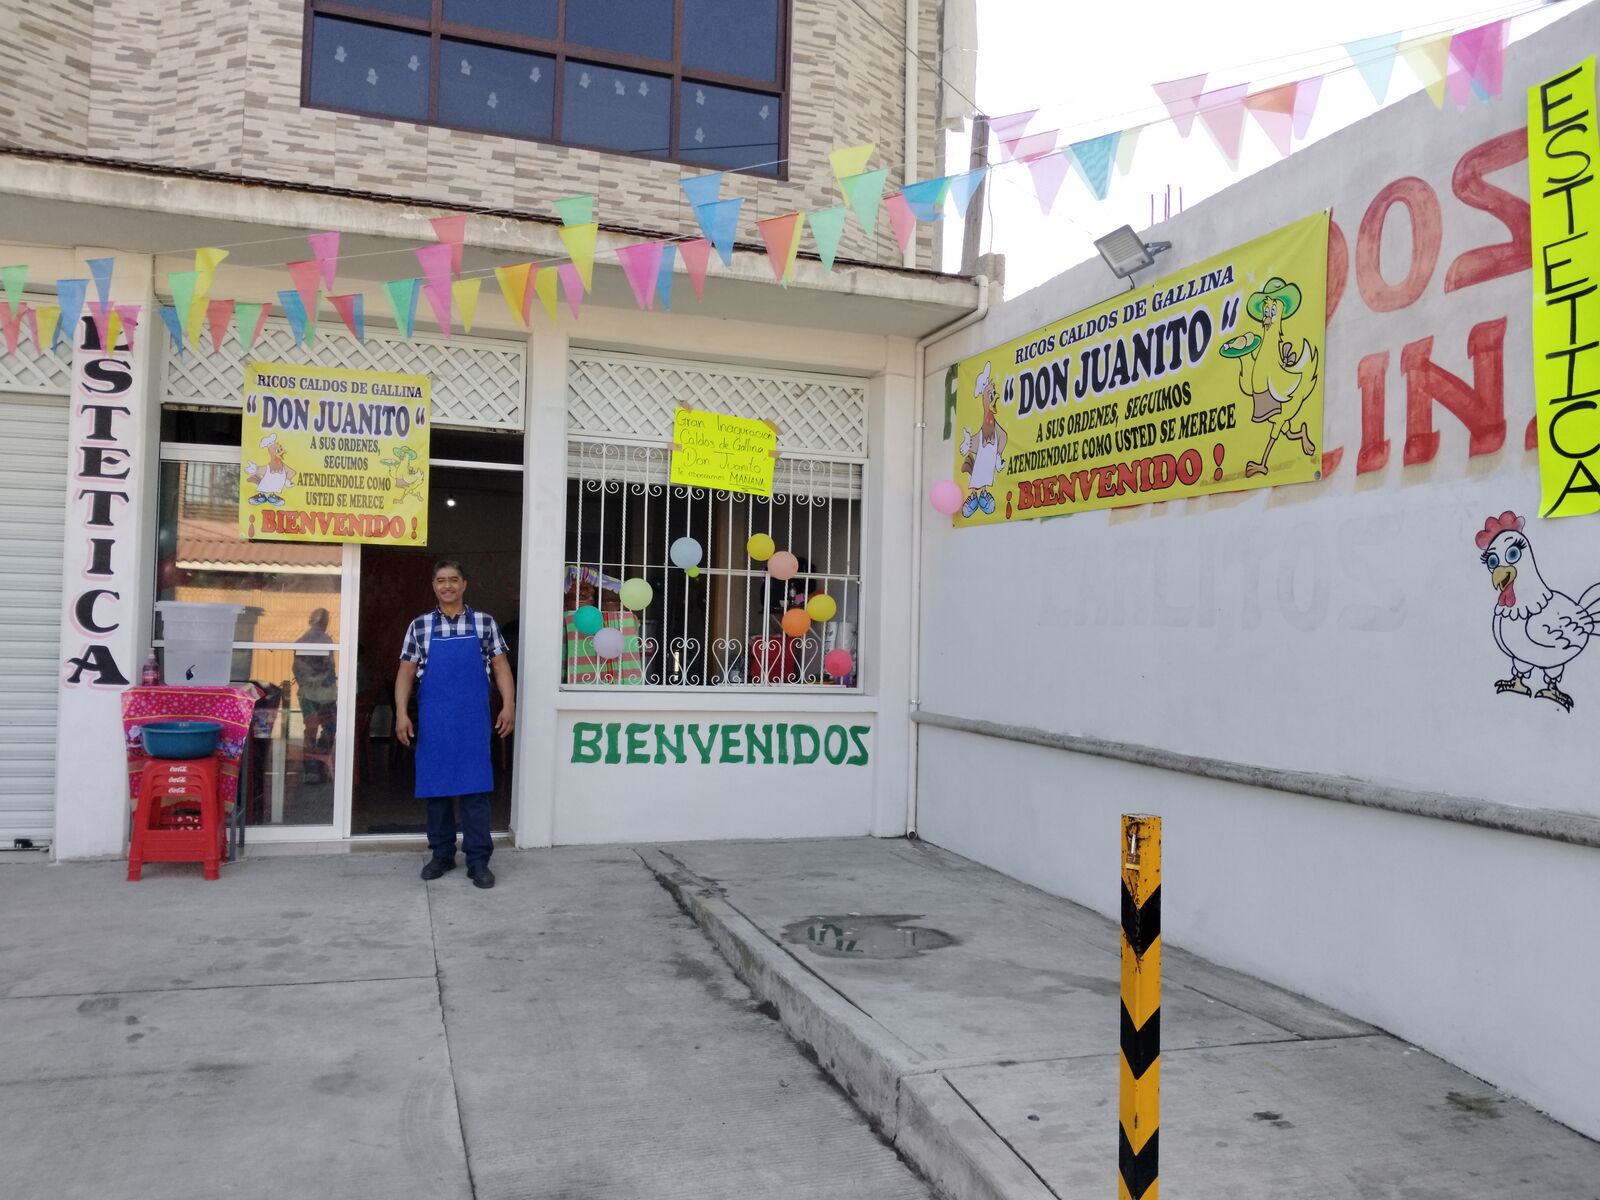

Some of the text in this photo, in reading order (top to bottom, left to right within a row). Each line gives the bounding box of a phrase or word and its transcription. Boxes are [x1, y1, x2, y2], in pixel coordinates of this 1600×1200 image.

[1540, 66, 1600, 519] ESTETICA
[1015, 265, 1234, 364] RICOS CALDOS DE GALLINA
[1018, 359, 1070, 415] DON
[1074, 309, 1212, 398] JUANITO
[257, 375, 422, 398] RICOS CALDOS DE GALLINA
[262, 396, 310, 431] DON
[314, 400, 410, 437] JUANITO
[676, 410, 705, 428] Gran
[1036, 381, 1192, 443] A SUS ORDENES, SEGUIMOS
[310, 436, 380, 456] A SUS ORDENES,
[680, 428, 715, 449] Caldos
[1007, 403, 1236, 475] ATENDIENDOLE COMO USTED SE MERECE
[324, 455, 368, 471] SEGUIMOS
[682, 447, 761, 474] Don Juanito
[297, 472, 391, 491] ATENDIENDOLE COMO
[1017, 449, 1202, 510] BIENVENIDO
[305, 491, 384, 509] USTED SE MERECE
[261, 509, 406, 539] BIENVENIDO
[570, 722, 871, 766] BIENVENIDOS
